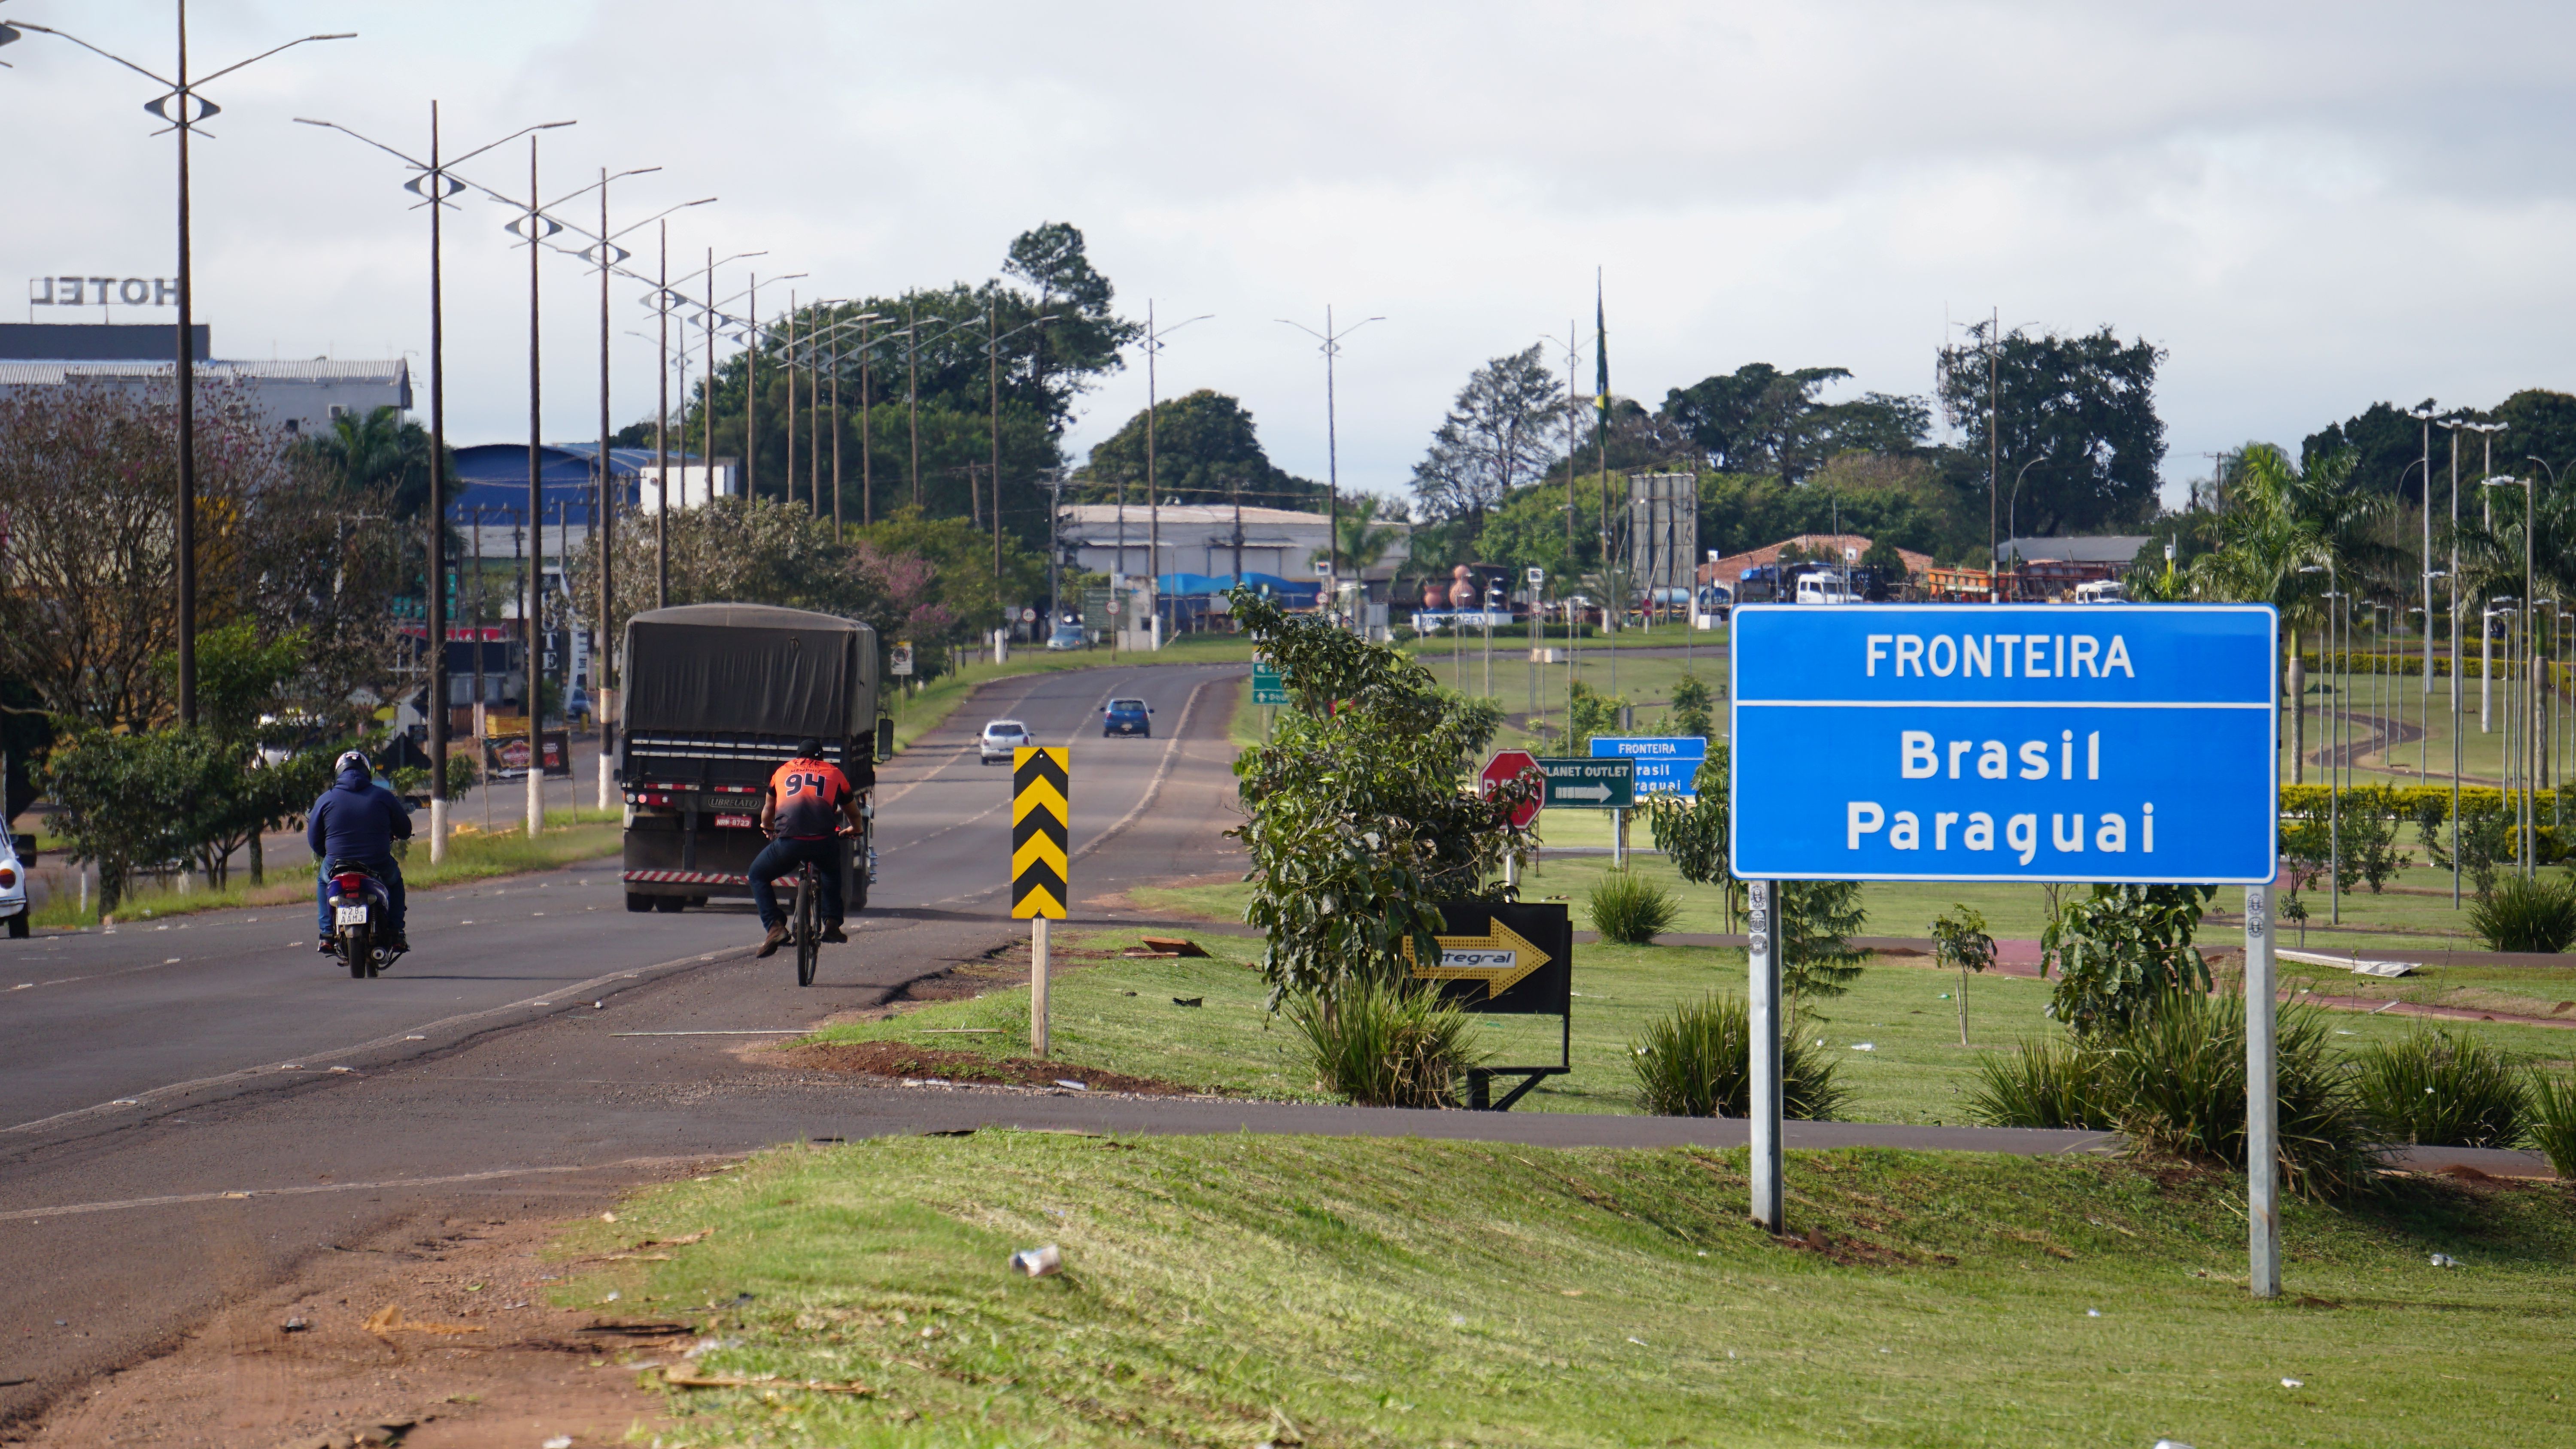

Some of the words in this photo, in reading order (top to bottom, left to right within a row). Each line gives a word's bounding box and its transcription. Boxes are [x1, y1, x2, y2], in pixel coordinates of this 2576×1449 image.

[1866, 634, 2136, 678] FRONTEIRA
[1619, 743, 1676, 754] FRONTEIRA
[1902, 730, 2099, 780] Brasil
[1585, 766, 1629, 777] OUTLET
[1635, 764, 1670, 776] rasil
[785, 773, 826, 797] 94
[1635, 780, 1681, 792] raguai
[711, 798, 758, 808] LIBRELATO
[1847, 801, 2154, 866] Paraguai
[340, 915, 363, 923] AAMJ
[1443, 953, 1511, 965] tegral
